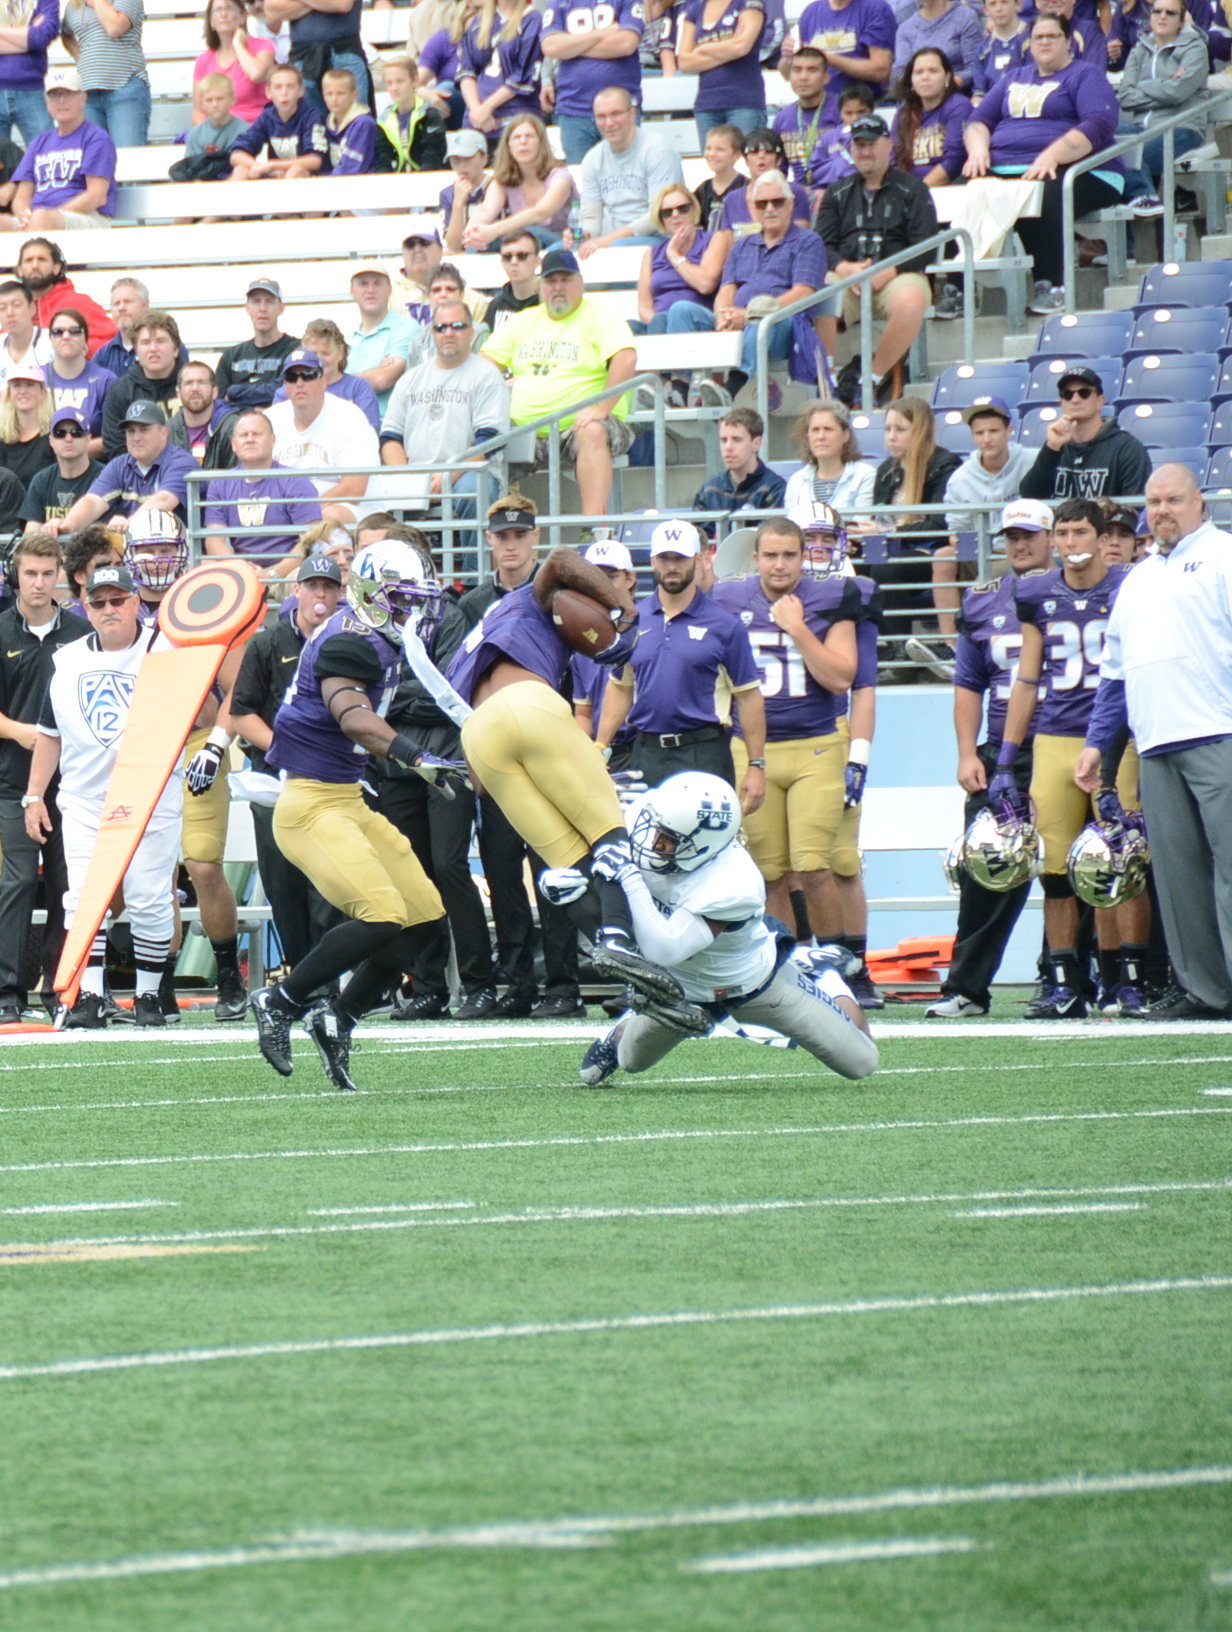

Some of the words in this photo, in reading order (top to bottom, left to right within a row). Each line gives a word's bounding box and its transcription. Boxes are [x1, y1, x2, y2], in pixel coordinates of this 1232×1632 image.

[1007, 81, 1061, 118] W
[126, 403, 145, 417] W
[1054, 467, 1109, 499] UW
[237, 496, 270, 527] W
[505, 511, 520, 522] W
[664, 530, 682, 541] W
[596, 547, 610, 556] W
[311, 559, 333, 573] W
[1183, 562, 1203, 573] W
[1074, 600, 1088, 611] W
[144, 617, 156, 627] W
[687, 625, 709, 641] W
[749, 631, 807, 698] 51
[85, 674, 135, 716] PAC
[96, 711, 119, 732] 12
[696, 810, 733, 823] STATE
